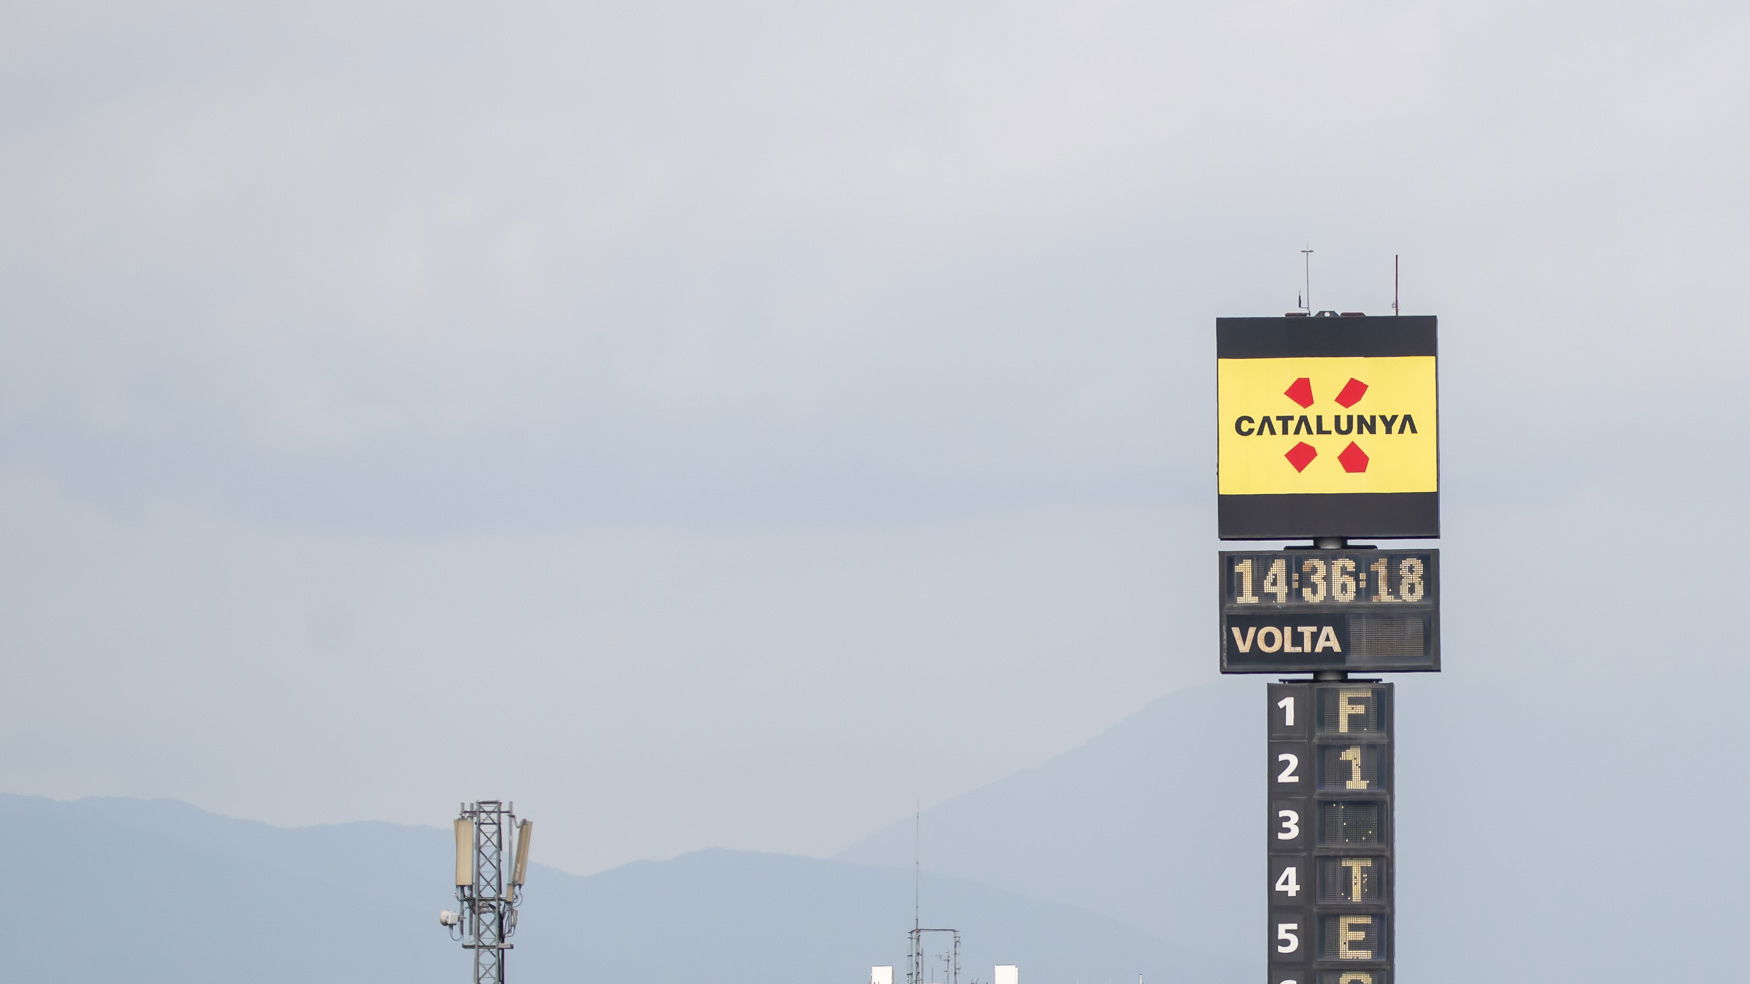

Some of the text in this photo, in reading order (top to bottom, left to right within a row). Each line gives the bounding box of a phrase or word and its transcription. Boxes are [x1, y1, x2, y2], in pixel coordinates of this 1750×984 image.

[1235, 414, 1418, 436] CATALUNYA
[1234, 557, 1425, 604] 14:36:18
[1231, 626, 1342, 653] VOLTA
[1278, 697, 1295, 726] 1
[1278, 753, 1299, 782] 2
[1278, 810, 1299, 839] 3
[1276, 867, 1300, 896] 4
[1278, 924, 1299, 953] 5
